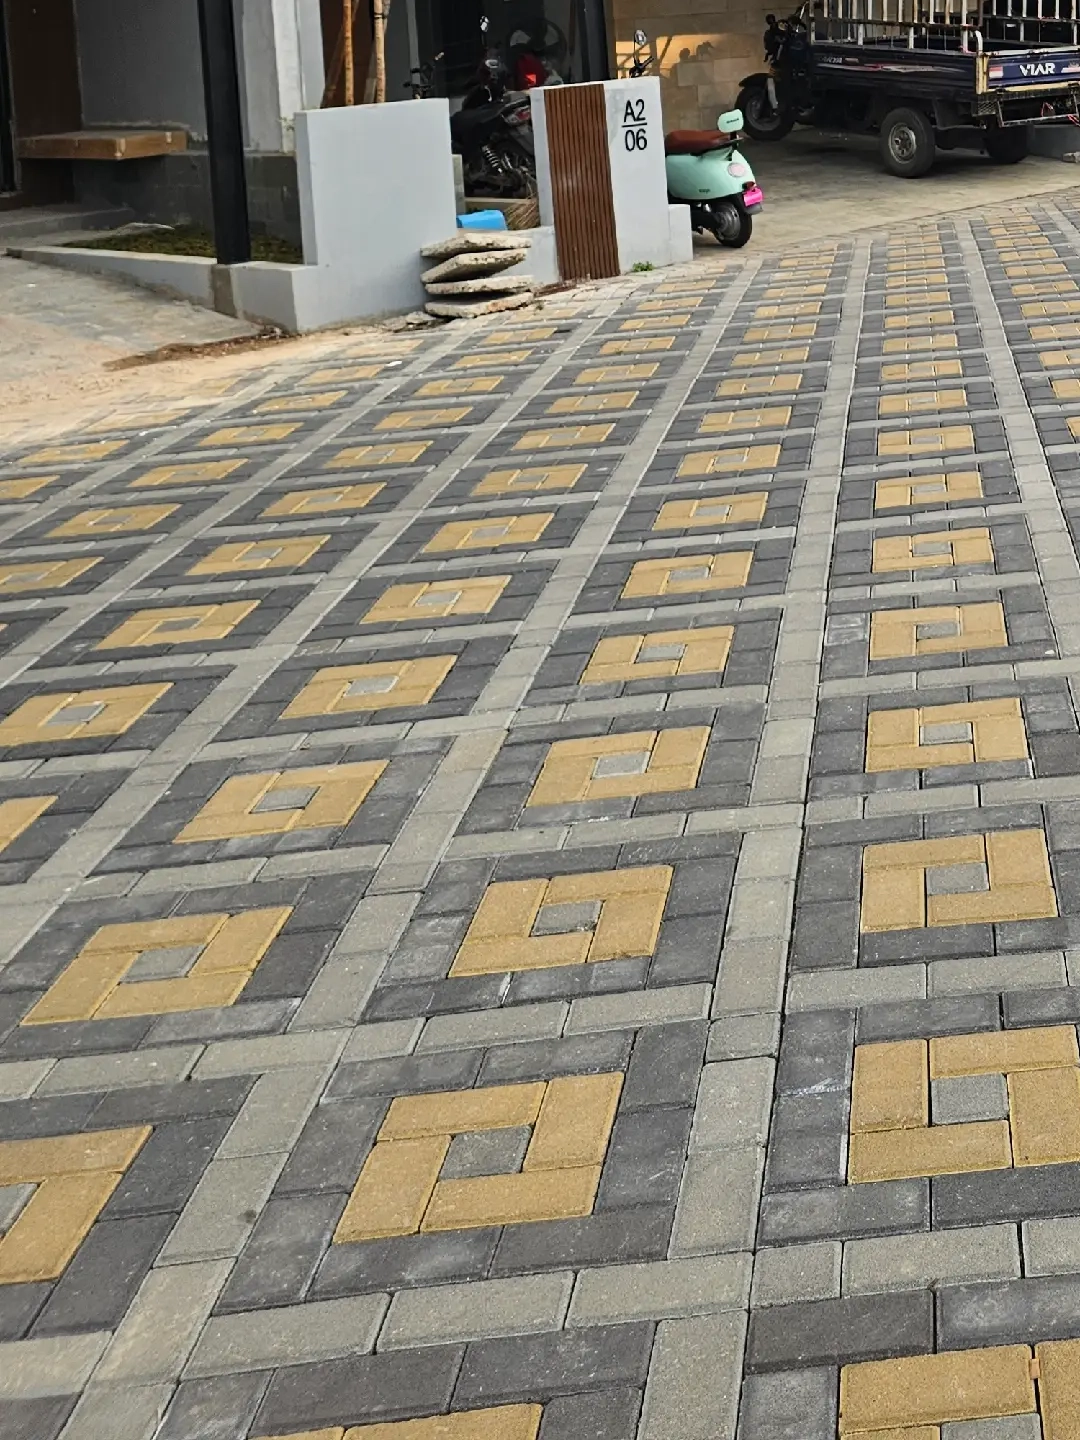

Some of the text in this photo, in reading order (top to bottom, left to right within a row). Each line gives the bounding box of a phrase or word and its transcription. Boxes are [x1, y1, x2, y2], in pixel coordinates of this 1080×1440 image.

[1019, 62, 1056, 77] VIAR
[623, 98, 646, 123] A2
[624, 128, 648, 152] 06
